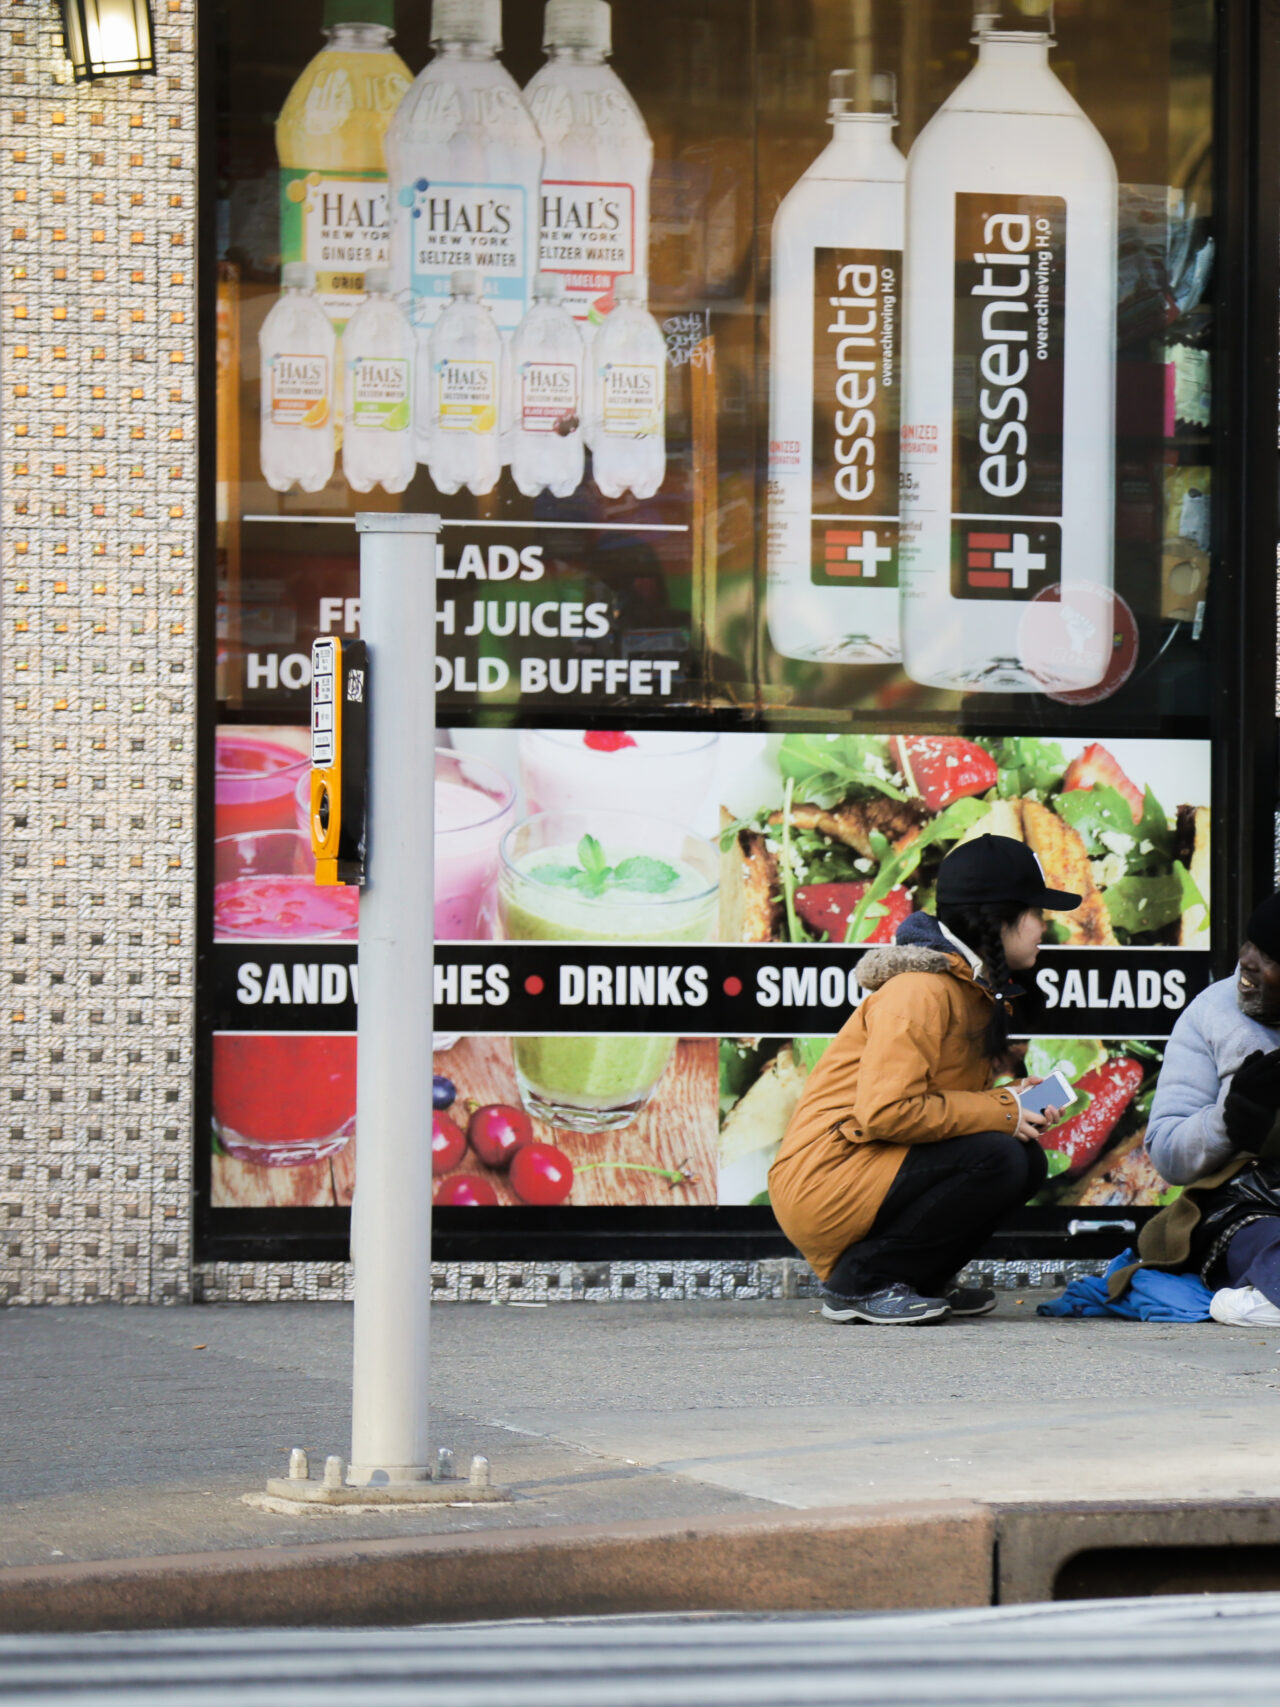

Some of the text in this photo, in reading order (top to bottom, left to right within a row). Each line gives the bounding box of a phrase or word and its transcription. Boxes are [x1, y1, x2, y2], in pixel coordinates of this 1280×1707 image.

[322, 193, 390, 228] HAL'
[428, 198, 511, 234] HAL'S
[541, 196, 619, 231] HAL'S
[362, 231, 390, 240] YOR
[428, 236, 509, 246] NEW YORK
[322, 247, 372, 260] GINGER
[419, 251, 516, 267] SELTZER WATER
[539, 247, 624, 261] ELTZER WATER
[332, 277, 364, 289] ORIG
[1034, 252, 1052, 360] overachieving
[881, 296, 896, 387] overachieving
[971, 213, 1031, 497] essentia
[827, 264, 877, 500] essentia
[769, 441, 800, 453] ONIZED
[901, 425, 938, 440] ONIZED
[437, 544, 544, 580] LADS
[465, 601, 609, 638] JUICES
[248, 654, 312, 690] HO
[436, 656, 509, 692] OLD
[520, 658, 679, 695] BUFFET
[238, 963, 509, 1006] SANDHES
[560, 965, 708, 1006] DRINKS
[1036, 969, 1186, 1009] SALADS
